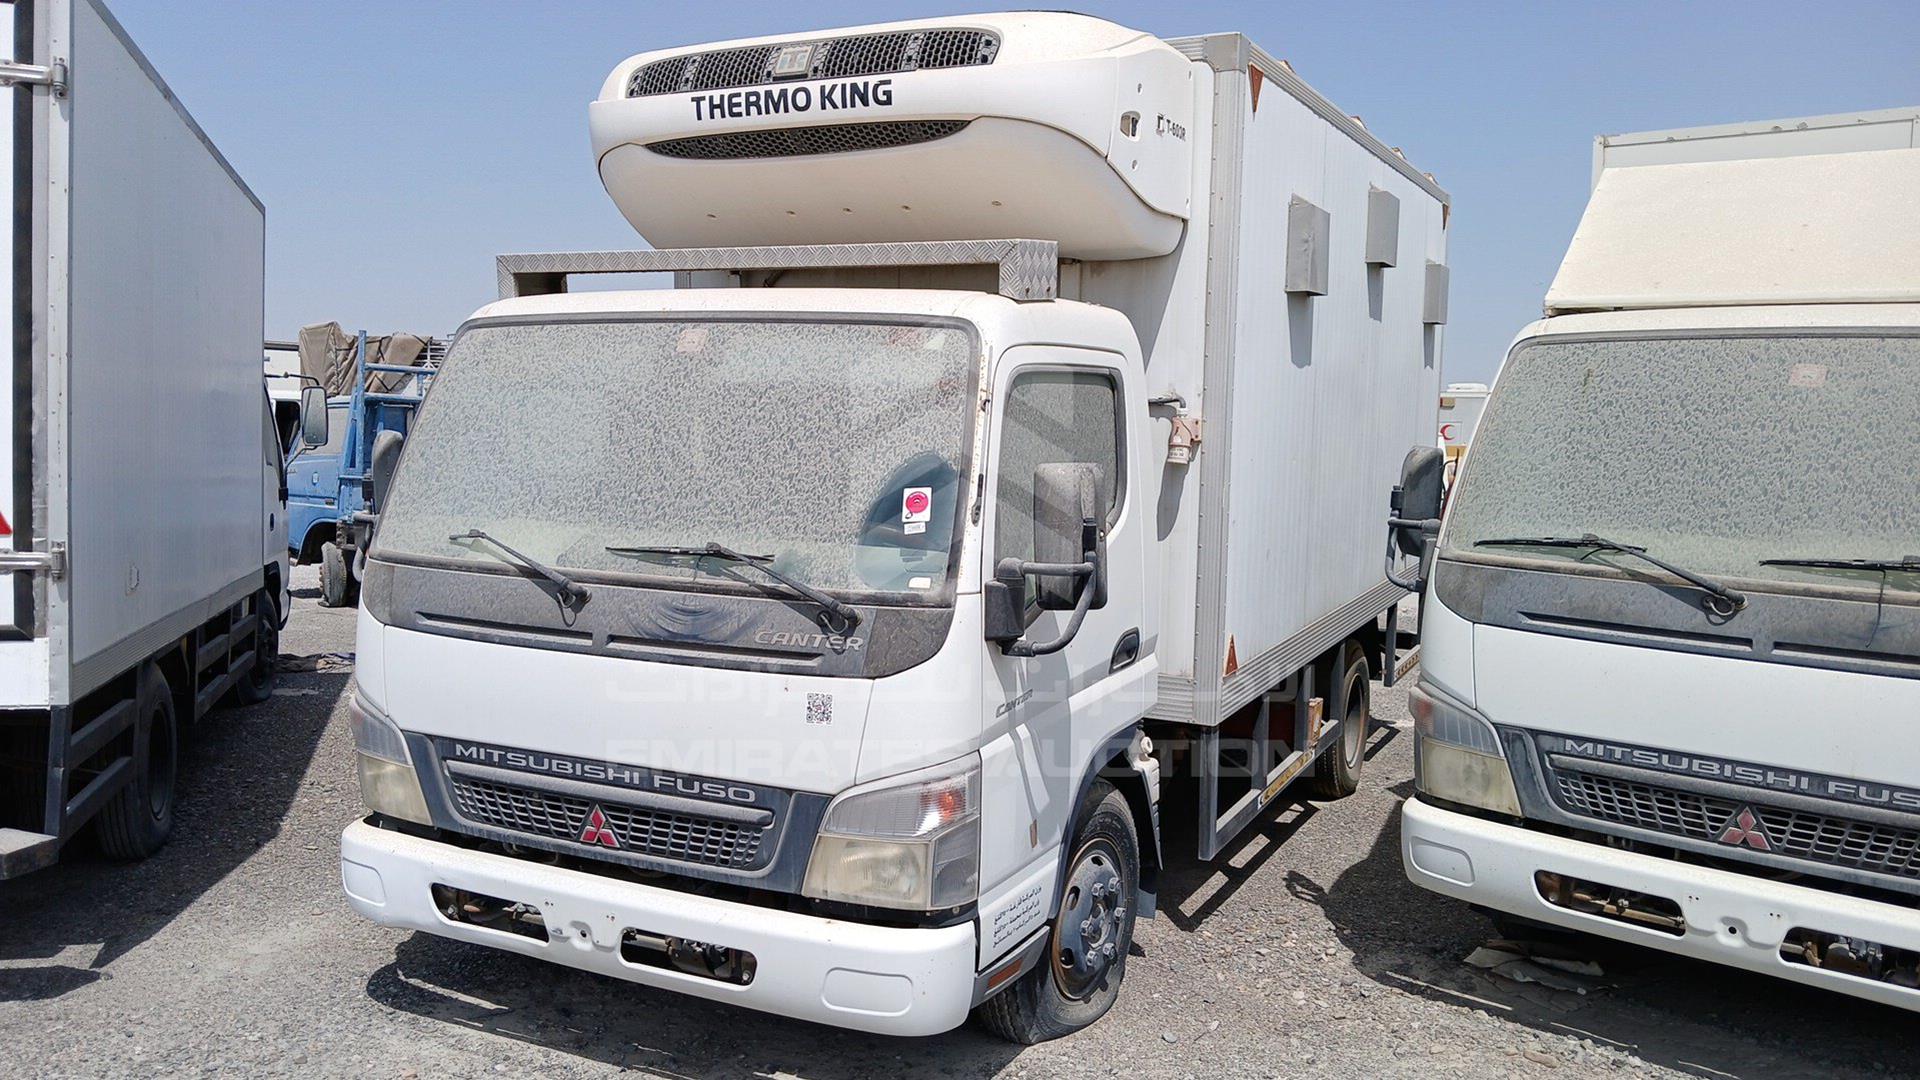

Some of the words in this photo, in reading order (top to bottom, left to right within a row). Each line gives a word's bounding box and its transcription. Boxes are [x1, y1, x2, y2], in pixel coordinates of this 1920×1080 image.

[691, 86, 811, 121] THERMO
[820, 79, 893, 111] KING
[754, 629, 864, 651] CANTER
[996, 689, 1033, 718] CANTER
[455, 743, 640, 785] MITSUBISHI
[653, 775, 756, 803] FUSO
[1565, 739, 1810, 790] MITSUBISHI
